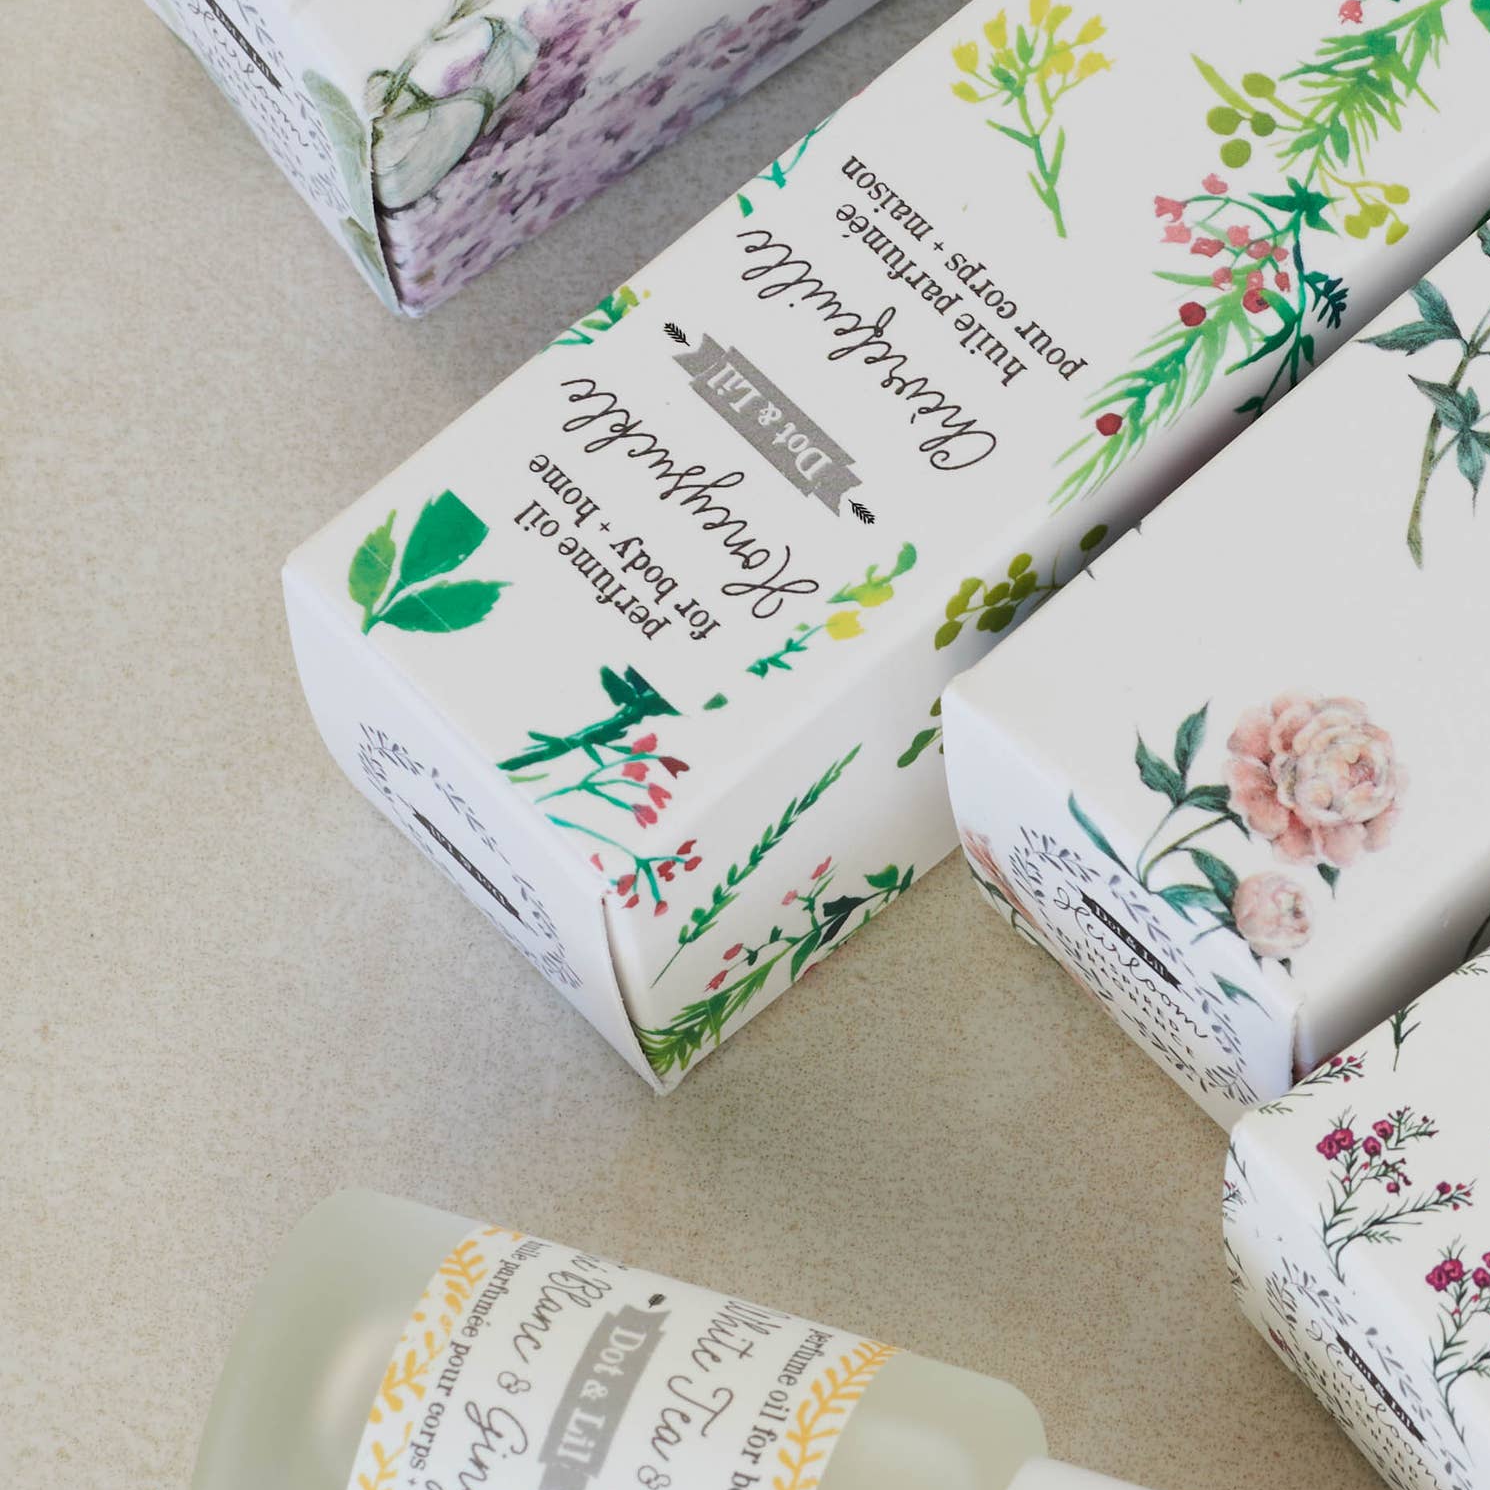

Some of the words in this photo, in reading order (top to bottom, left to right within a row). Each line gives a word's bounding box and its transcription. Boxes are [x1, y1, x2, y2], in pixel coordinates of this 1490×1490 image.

[840, 154, 935, 243] maison
[835, 203, 965, 317] parfumée
[943, 252, 1019, 320] corps
[735, 229, 998, 472] Chèvrefeuille
[953, 312, 1029, 388] huile
[1013, 320, 1090, 382] pour
[707, 363, 758, 412] Lil
[778, 424, 833, 481] Dot
[513, 498, 561, 538] oil
[528, 453, 601, 529] home
[559, 377, 821, 620] Honeysuckle
[557, 536, 673, 642] perfume
[608, 535, 680, 606] body
[672, 597, 722, 641] for
[1056, 886, 1209, 1038] Heirloom
[512, 1270, 613, 1365] Blanc
[594, 1325, 647, 1378] Dot
[691, 1300, 791, 1372] White
[435, 1340, 473, 1398] pour
[496, 1370, 532, 1395] &
[409, 1401, 446, 1471] corps
[557, 1407, 606, 1462] Lil
[652, 1375, 733, 1461] Tea
[759, 1390, 790, 1422] oil
[636, 1464, 672, 1490] &
[741, 1427, 777, 1465] for
